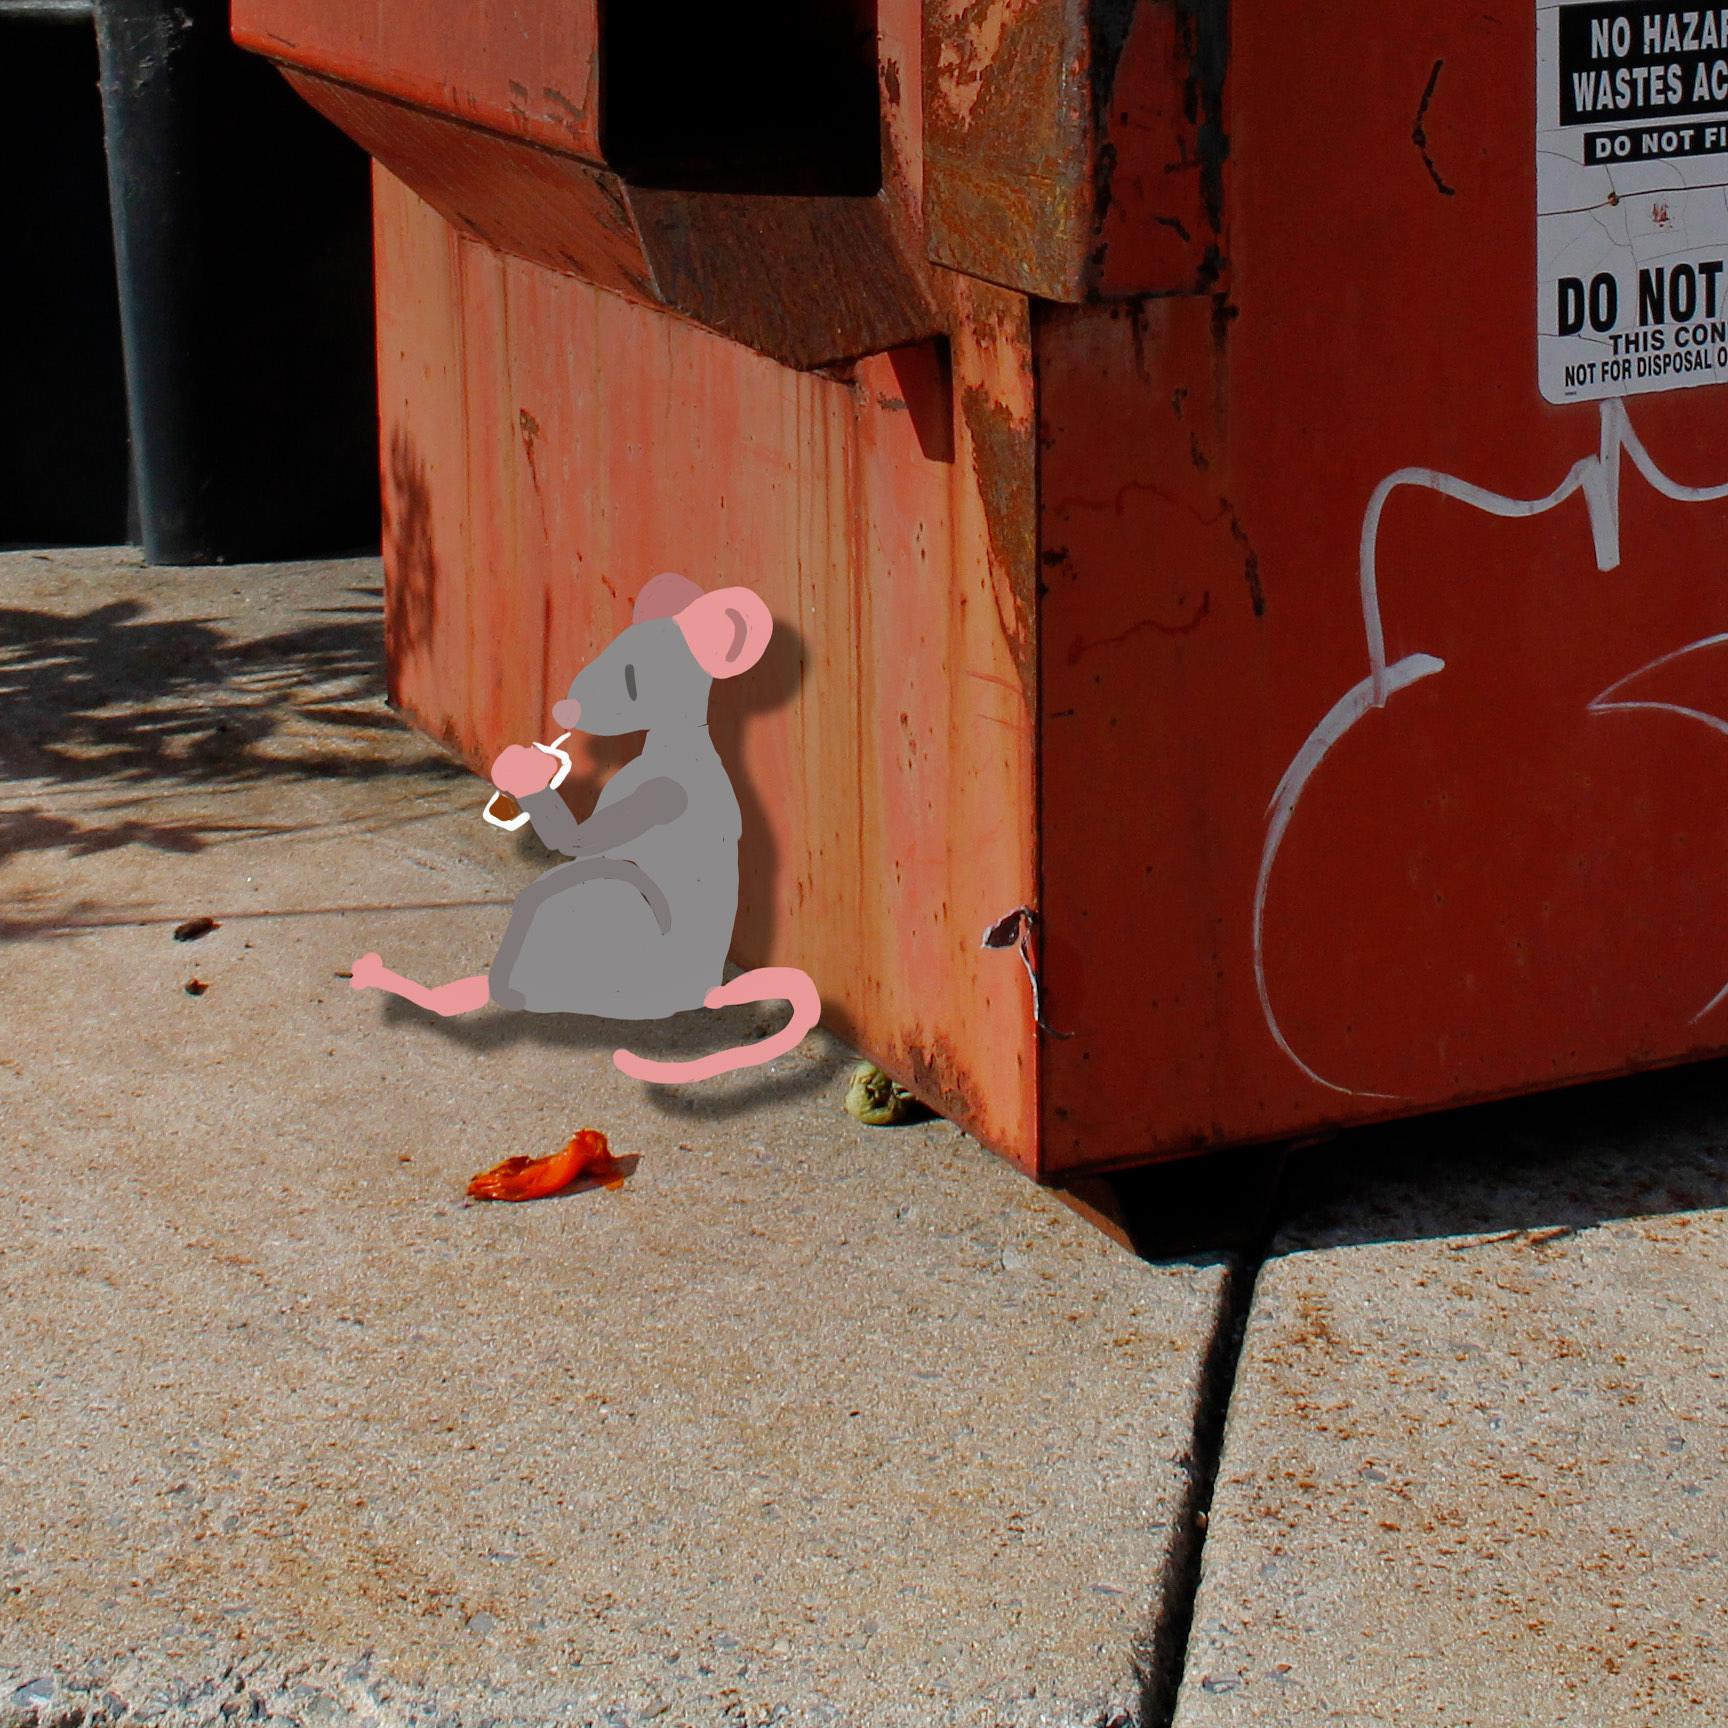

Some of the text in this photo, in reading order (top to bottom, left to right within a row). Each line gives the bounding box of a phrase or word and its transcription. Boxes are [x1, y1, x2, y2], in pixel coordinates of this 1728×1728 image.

[1591, 16, 1631, 59] NO
[1572, 62, 1683, 113] WASTES
[1595, 135, 1631, 159] DO
[1642, 129, 1695, 155] NOT
[1557, 272, 1618, 337] DO
[1638, 260, 1723, 327] NOT
[1609, 328, 1665, 356] THIS
[1565, 362, 1596, 387] NOT
[1601, 358, 1632, 382] FOR
[1637, 348, 1712, 378] DISPOSAL
